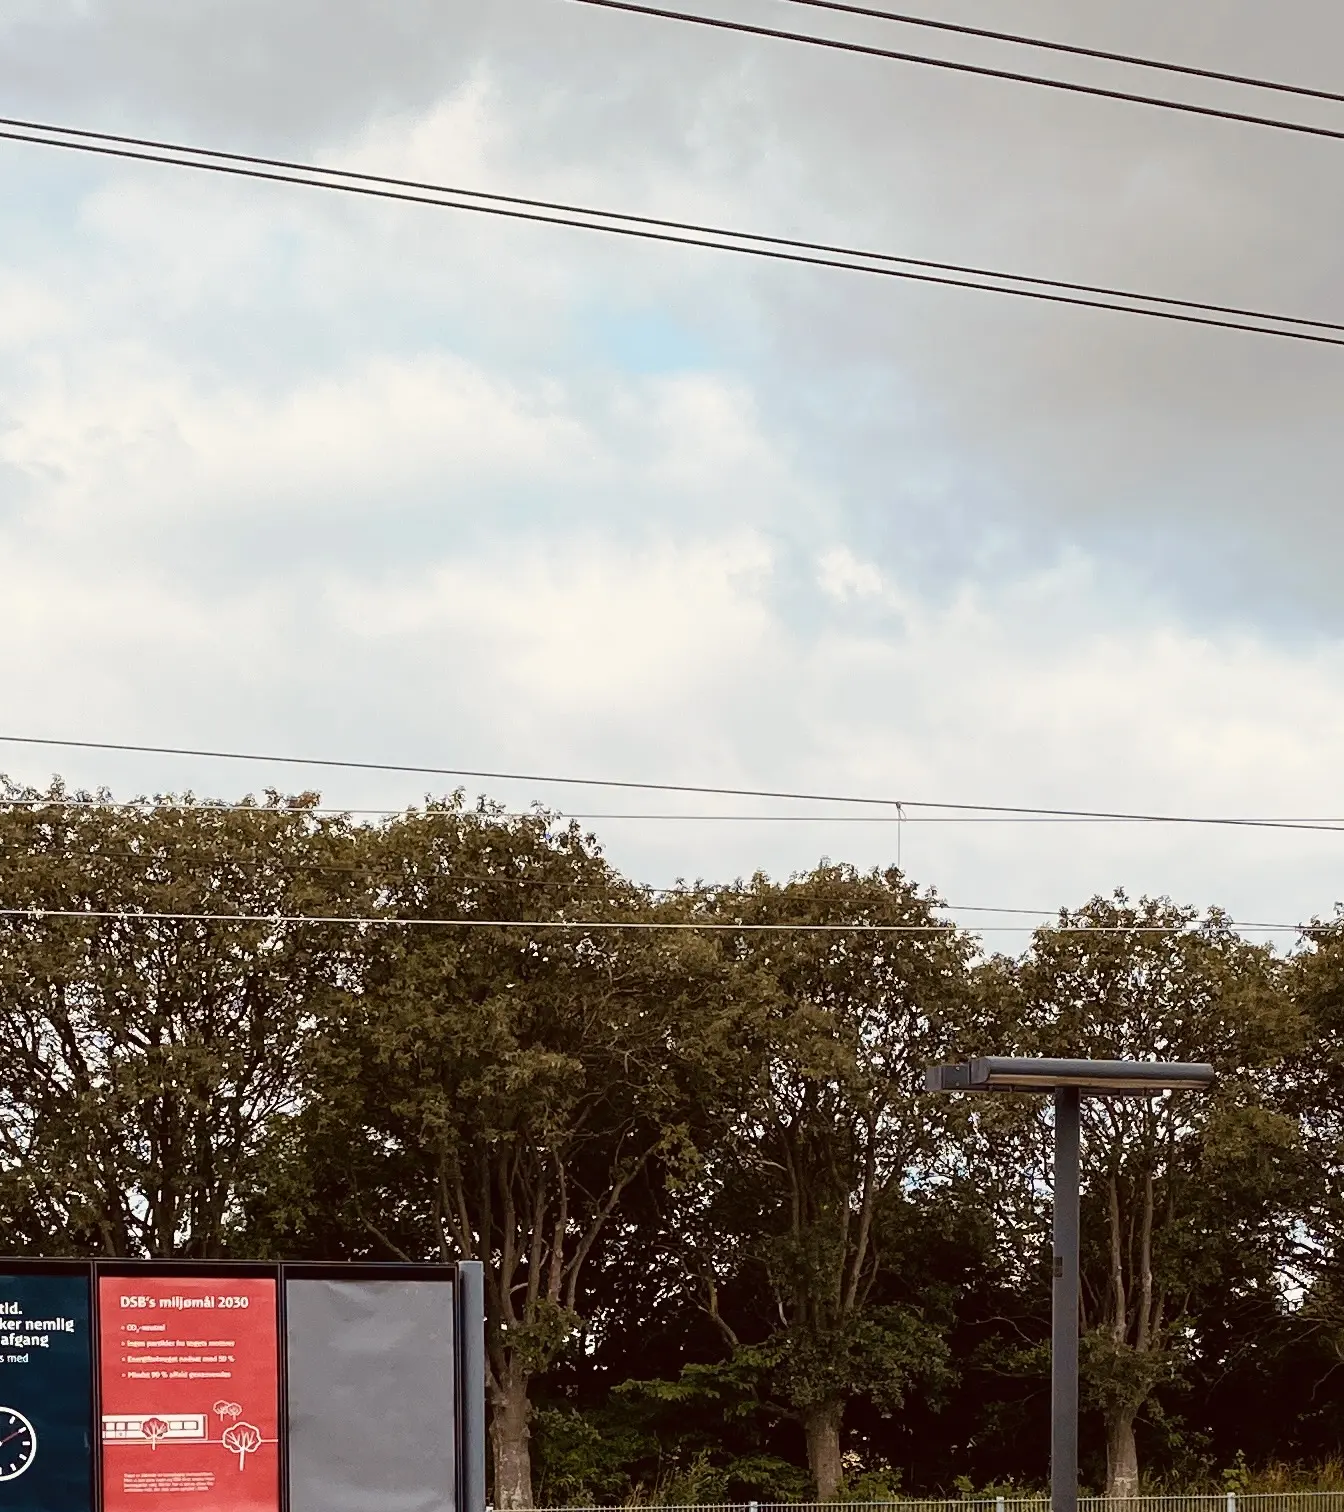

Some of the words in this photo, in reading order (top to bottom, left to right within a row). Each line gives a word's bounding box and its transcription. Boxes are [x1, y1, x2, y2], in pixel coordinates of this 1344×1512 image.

[159, 1296, 214, 1310] miljømål
[218, 1297, 248, 1308] 2030
[25, 1318, 74, 1332] nemlig
[1, 1333, 49, 1347] afgang
[7, 1353, 28, 1363] med
